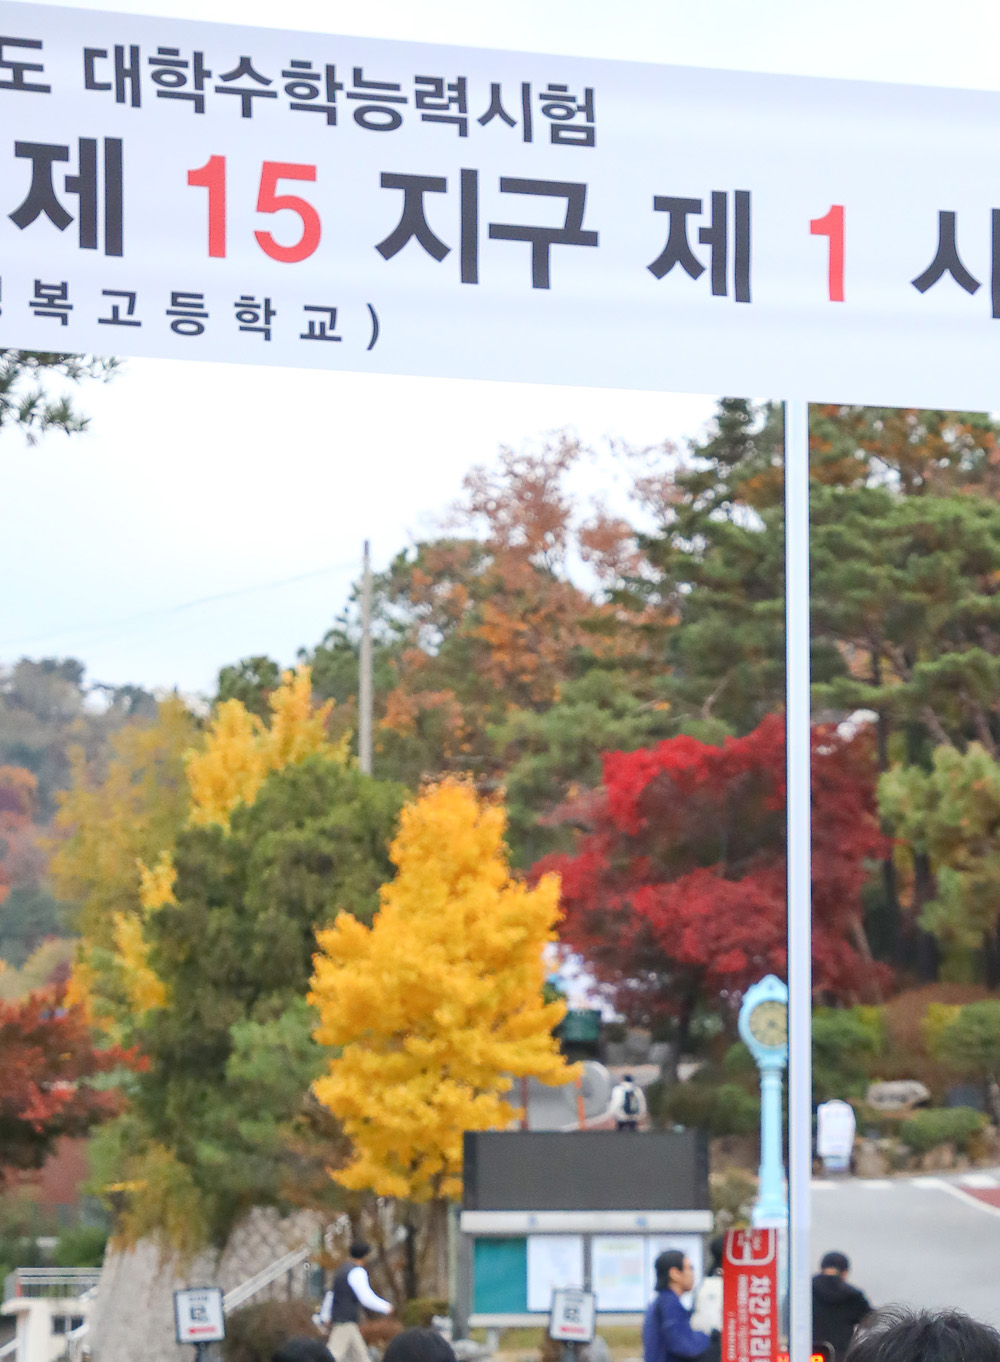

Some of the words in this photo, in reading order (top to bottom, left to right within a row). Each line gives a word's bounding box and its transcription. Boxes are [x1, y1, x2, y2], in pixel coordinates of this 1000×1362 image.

[83, 44, 598, 148] 대학수학능력시험
[8, 136, 124, 258] 제
[187, 155, 322, 264] 15
[374, 169, 600, 290] 지구
[646, 189, 751, 304] 제
[809, 204, 845, 303] 1
[0, 276, 380, 351] 복고등학교)
